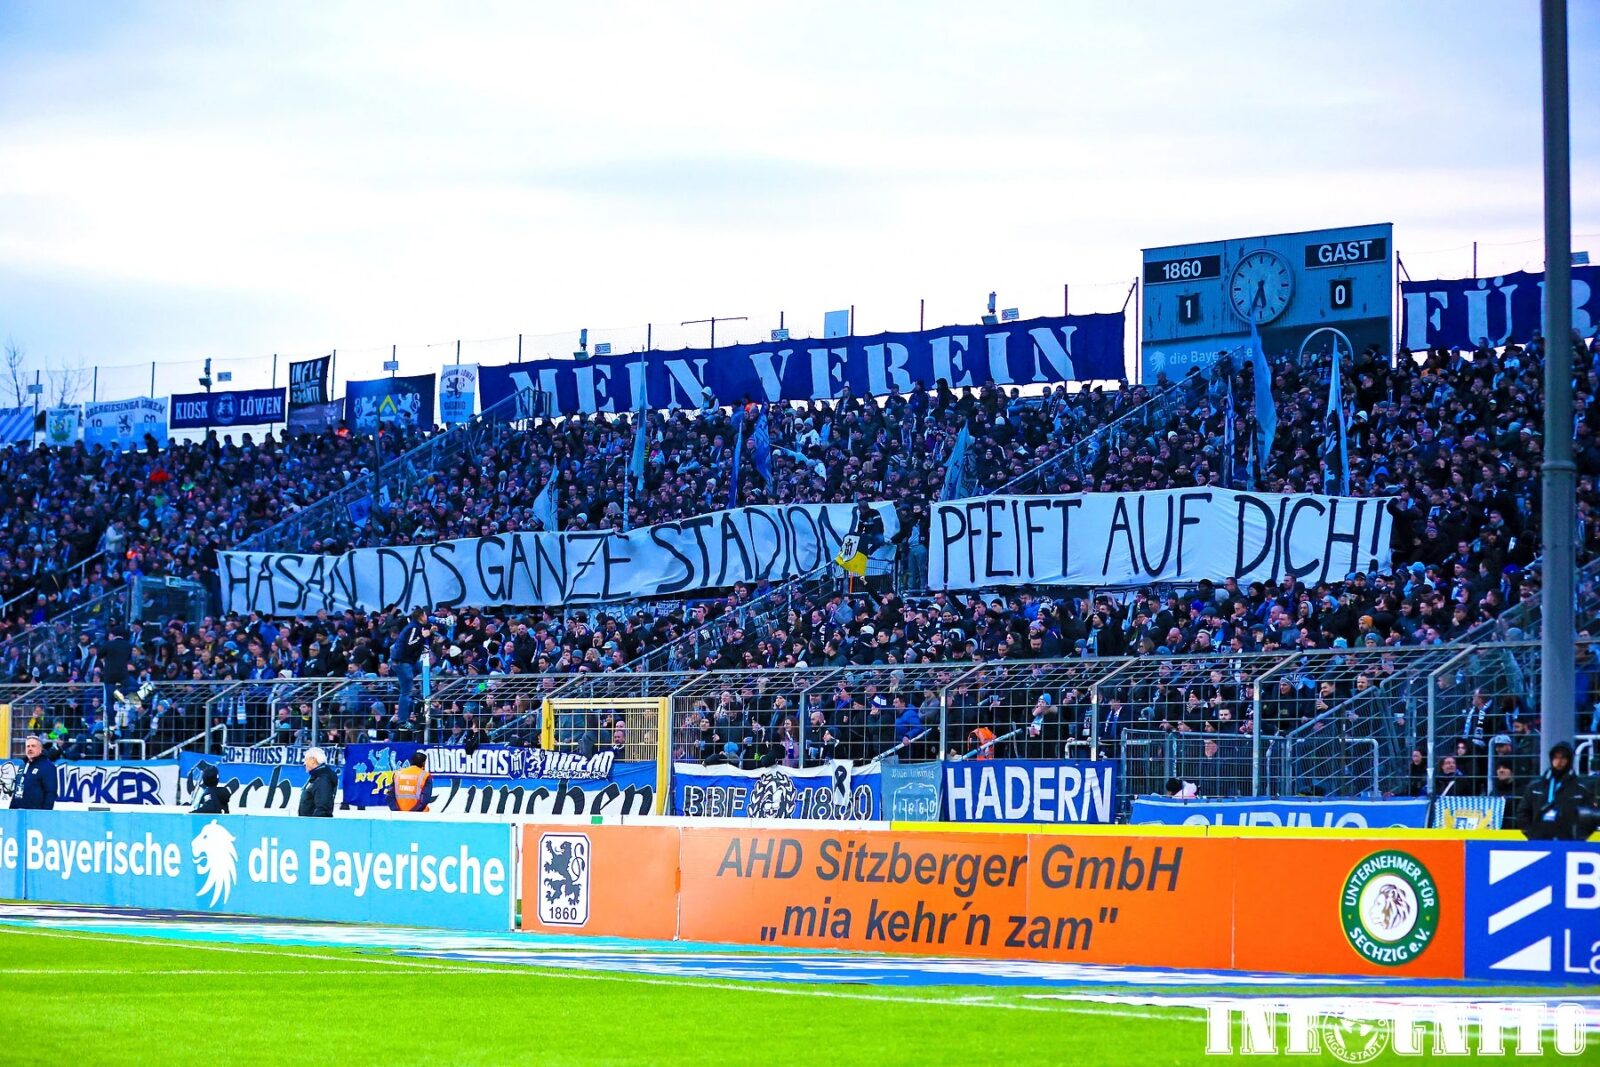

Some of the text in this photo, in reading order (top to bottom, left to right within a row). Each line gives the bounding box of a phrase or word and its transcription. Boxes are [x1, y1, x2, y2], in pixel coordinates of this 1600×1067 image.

[1318, 241, 1373, 263] GAST
[1162, 260, 1202, 280] 1860
[1185, 300, 1192, 319] 1
[1335, 285, 1346, 305] 0
[509, 326, 1078, 421] MEIN VEREIN
[1169, 352, 1188, 365] die
[175, 401, 209, 420] KIOSK
[240, 396, 282, 416] LÖWEN
[939, 493, 1387, 583] PFEIFT AUF DICH!
[223, 504, 860, 615] HASAN DAS GANZE STADION
[222, 746, 245, 763] 50+1
[249, 746, 282, 764] MUSS
[56, 762, 163, 806] ACKER
[683, 785, 747, 818] BBF
[948, 766, 1113, 823] HADERN
[26, 829, 182, 880] Bayerische
[248, 837, 505, 897] die Bayerische
[716, 838, 1184, 898] AHD Sitzberger GmbH
[1345, 855, 1435, 908] UNTERNEHMER FÜR
[548, 906, 578, 922] 1860
[1349, 927, 1408, 962] SECHZIG
